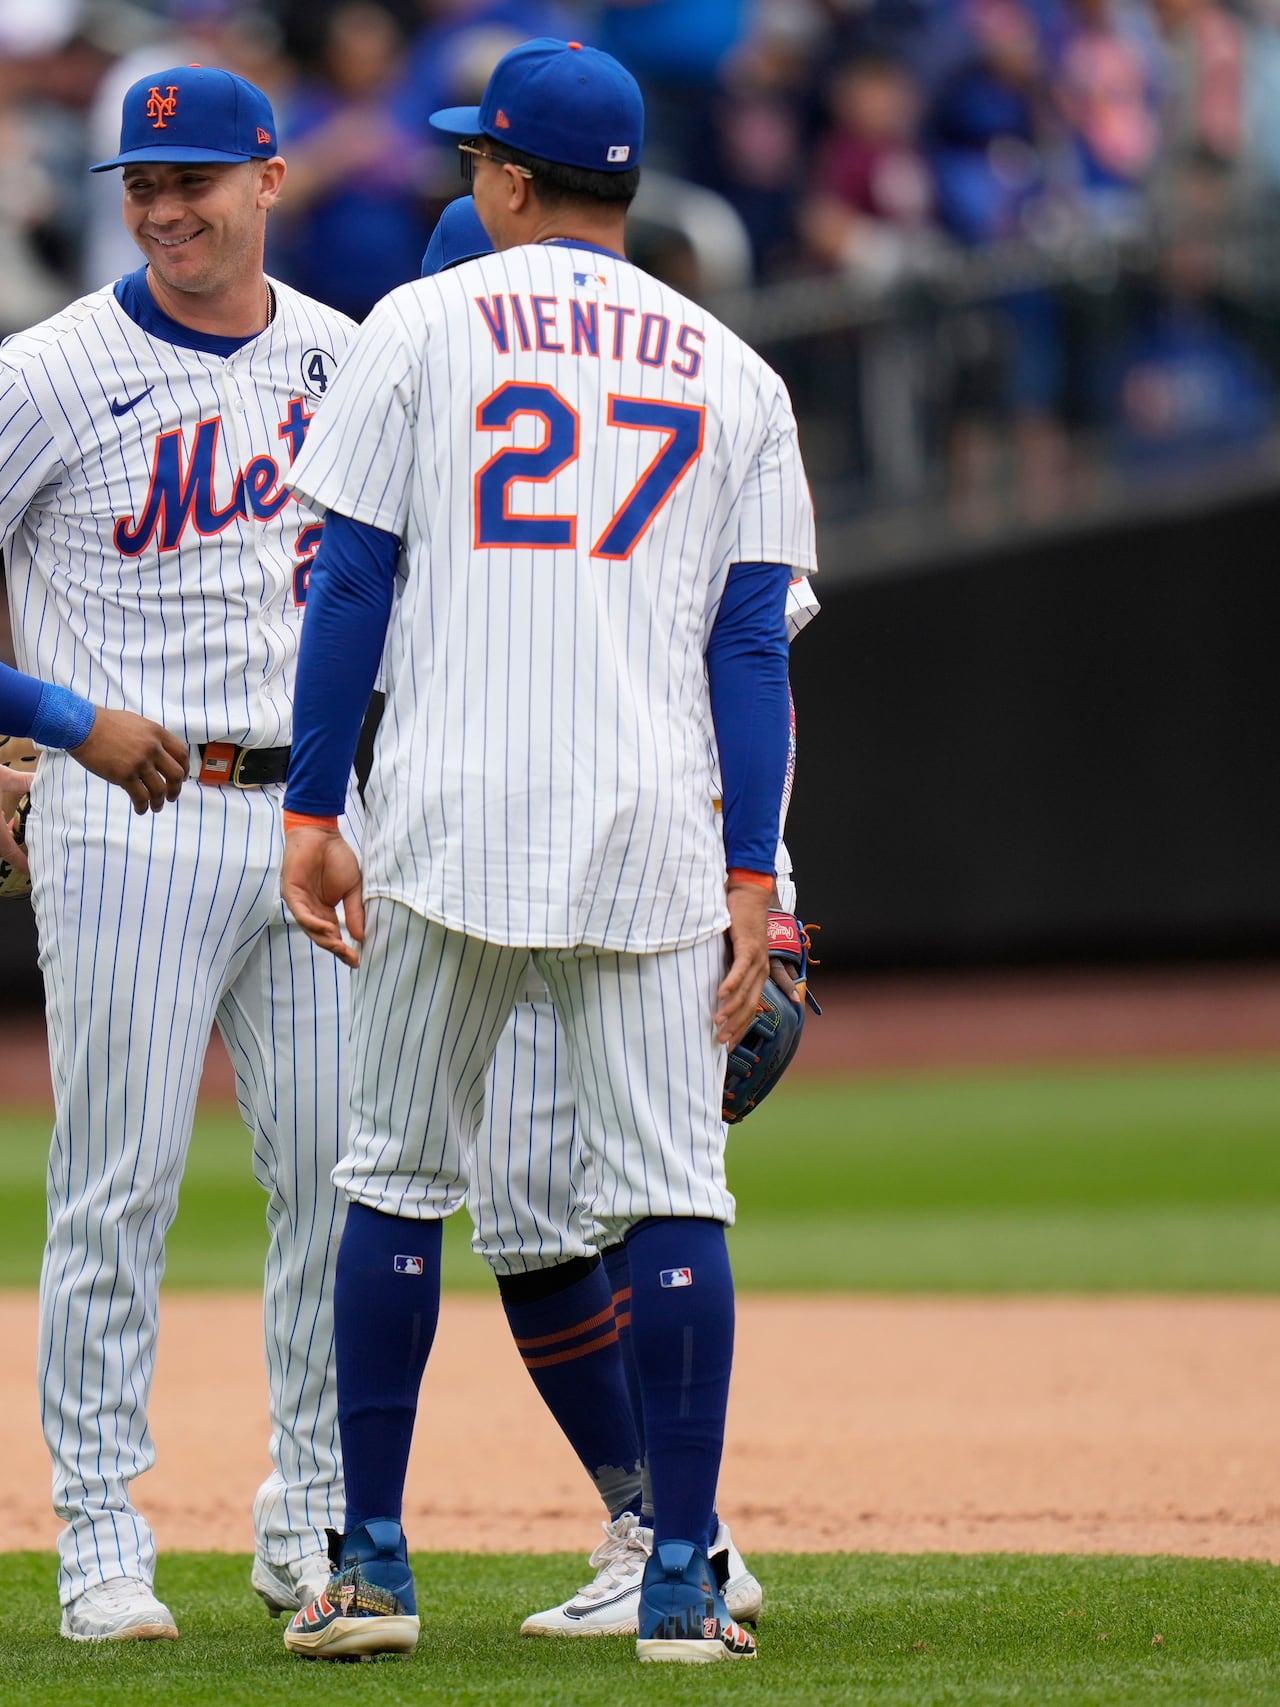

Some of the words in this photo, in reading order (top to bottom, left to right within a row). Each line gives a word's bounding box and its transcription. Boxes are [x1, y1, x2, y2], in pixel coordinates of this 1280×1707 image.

[307, 354, 328, 393] 4
[474, 293, 706, 380] VIENTOS
[113, 397, 317, 557] Met
[473, 380, 706, 561] 27
[703, 1617, 717, 1639] 27
